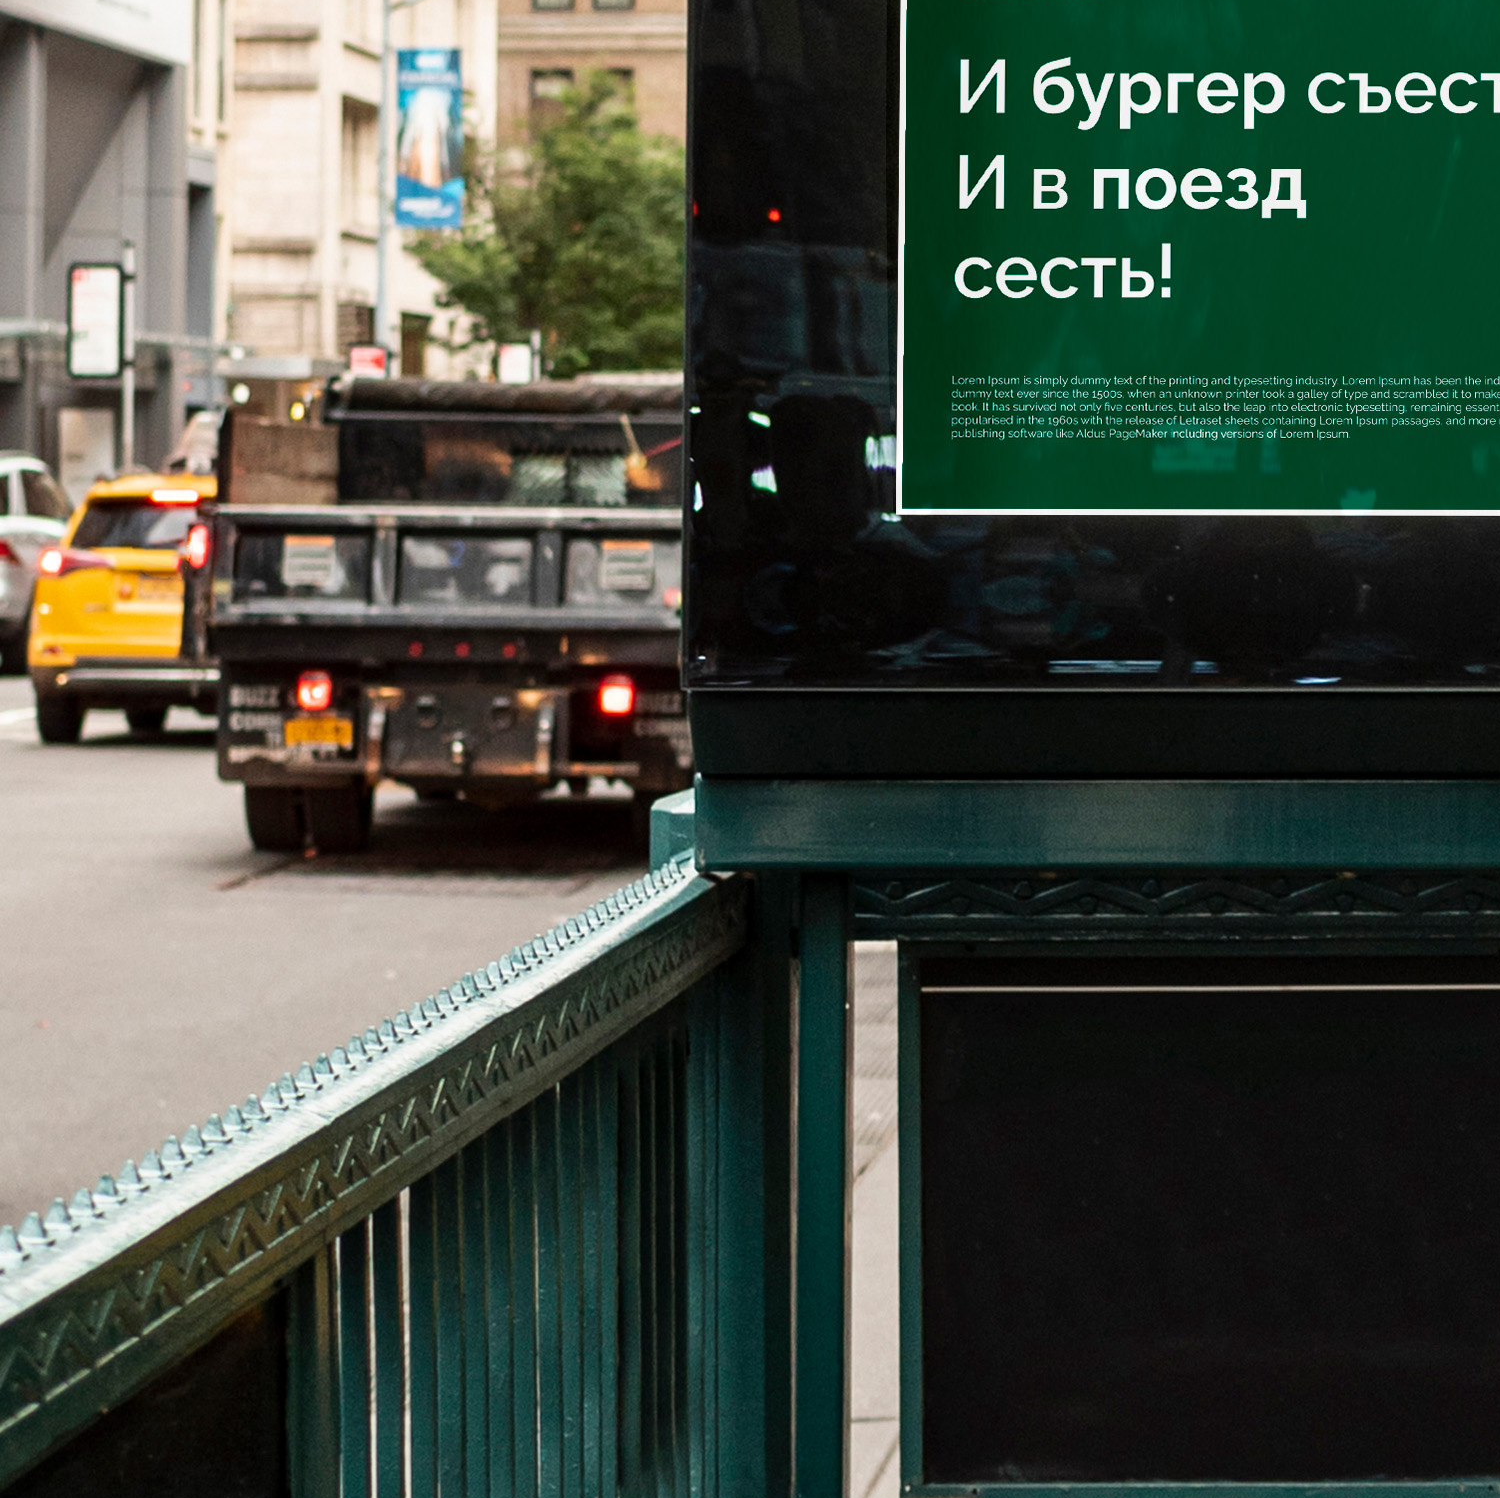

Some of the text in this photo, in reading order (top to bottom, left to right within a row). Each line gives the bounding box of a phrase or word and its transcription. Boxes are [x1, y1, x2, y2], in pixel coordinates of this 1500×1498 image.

[959, 59, 1006, 114] И
[1033, 56, 1285, 131] бургер
[958, 154, 1307, 219] И в поезд
[954, 243, 1172, 299] сесть!
[951, 376, 984, 384] Lorem
[987, 376, 1019, 387] Ipsum
[1023, 376, 1031, 384] is
[1033, 376, 1068, 388] simply
[1070, 376, 1111, 388] dummy
[1113, 376, 1133, 385] text
[1135, 376, 1147, 385] of
[1148, 376, 1166, 385] the
[1168, 376, 1208, 388] printing
[1210, 376, 1230, 385] and
[1233, 376, 1292, 388] typesetting
[1342, 376, 1375, 385] Lorem
[1378, 377, 1410, 387] Ipsum
[1413, 376, 1431, 385] has
[1435, 377, 1461, 385] been
[1464, 376, 1481, 385] the
[951, 389, 992, 402] dummy
[994, 390, 1013, 398] text
[1042, 389, 1069, 398] since
[1072, 389, 1089, 398] the
[1126, 389, 1155, 398] when
[1174, 389, 1222, 398] unknown
[1225, 389, 1259, 402] printer
[1262, 389, 1285, 398] took
[1296, 389, 1328, 402] galley
[1330, 389, 1342, 398] of
[1344, 390, 1368, 402] type
[1370, 390, 1390, 398] and
[1392, 389, 1449, 398] scrambled
[1452, 389, 1458, 398] it
[1460, 390, 1471, 398] to
[982, 403, 988, 411] It
[992, 402, 1010, 411] has
[1012, 402, 1056, 411] survived
[1060, 403, 1076, 411] not
[1079, 403, 1102, 415] only
[1104, 402, 1122, 411] five
[1178, 403, 1196, 411] but
[1198, 403, 1220, 411] also
[1223, 403, 1240, 411] the
[1243, 403, 1266, 413] leap
[1268, 403, 1288, 411] into
[1290, 403, 1343, 411] electronic
[1410, 403, 1461, 414] remaining
[951, 416, 1013, 428] popularised
[1027, 415, 1044, 424] the
[1047, 416, 1078, 428] 1960s
[1080, 414, 1102, 425] with
[1105, 416, 1122, 425] the
[1125, 416, 1163, 425] release
[1165, 416, 1176, 425] of
[1179, 416, 1221, 425] Letraset
[1224, 416, 1258, 425] sheets
[1261, 416, 1316, 428] containing
[1319, 414, 1352, 425] Lorem
[1356, 416, 1387, 427] Ipsum
[1445, 414, 1465, 425] and
[951, 428, 1350, 441] publishing software like Aldus PageMaker including versions of Lorem Ipsum.
